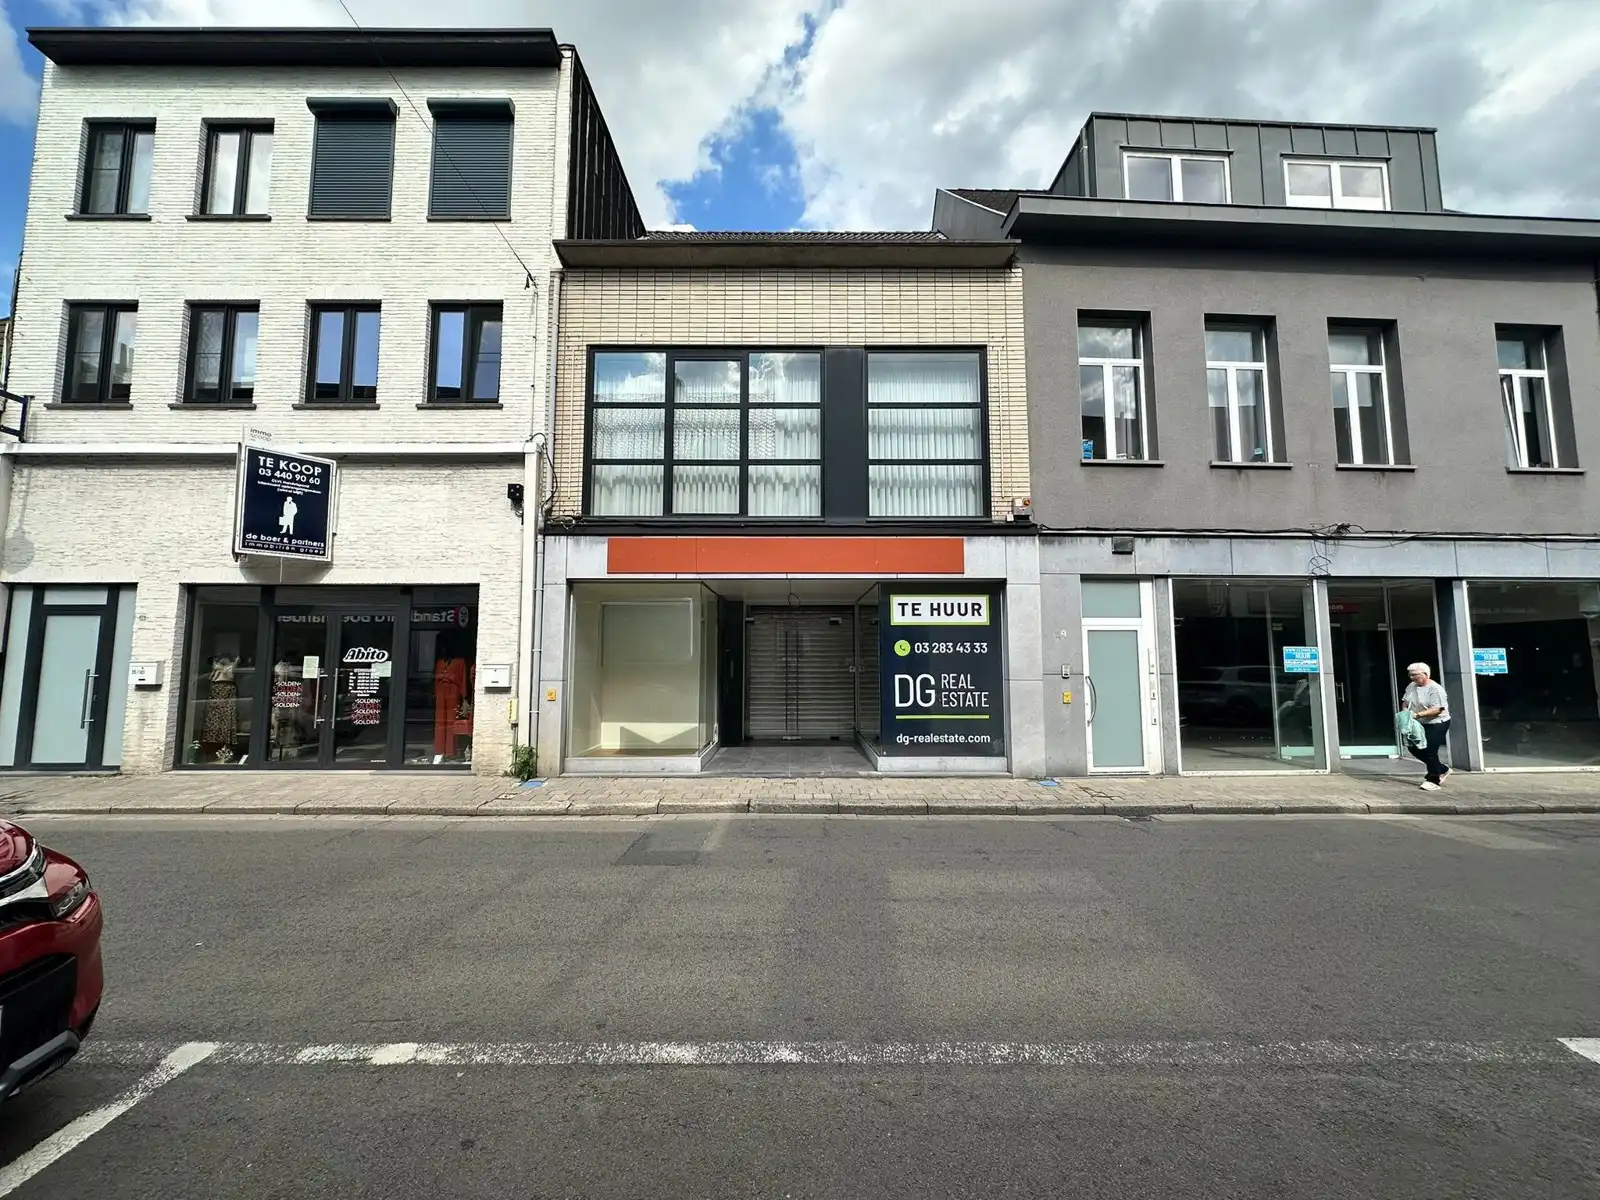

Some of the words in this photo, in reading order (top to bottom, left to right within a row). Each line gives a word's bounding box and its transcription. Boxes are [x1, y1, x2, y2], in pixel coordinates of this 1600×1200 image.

[250, 428, 272, 437] immo
[258, 456, 274, 468] TE
[279, 460, 322, 476] KOOP
[258, 467, 272, 477] 03
[274, 472, 293, 480] 440
[295, 474, 307, 483] 90
[309, 477, 321, 485] 60
[260, 534, 281, 543] boer
[291, 539, 325, 548] partners
[897, 602, 922, 617] TE
[930, 602, 983, 617] HUUR
[343, 647, 389, 662] Abito
[914, 642, 930, 653] 03
[932, 642, 953, 653] 283
[956, 642, 971, 653] 43
[973, 642, 988, 653] 33
[941, 673, 976, 689] REAL
[894, 673, 936, 708] DG
[941, 691, 990, 708] ESTATE
[896, 733, 991, 745] dg-realestate.com
